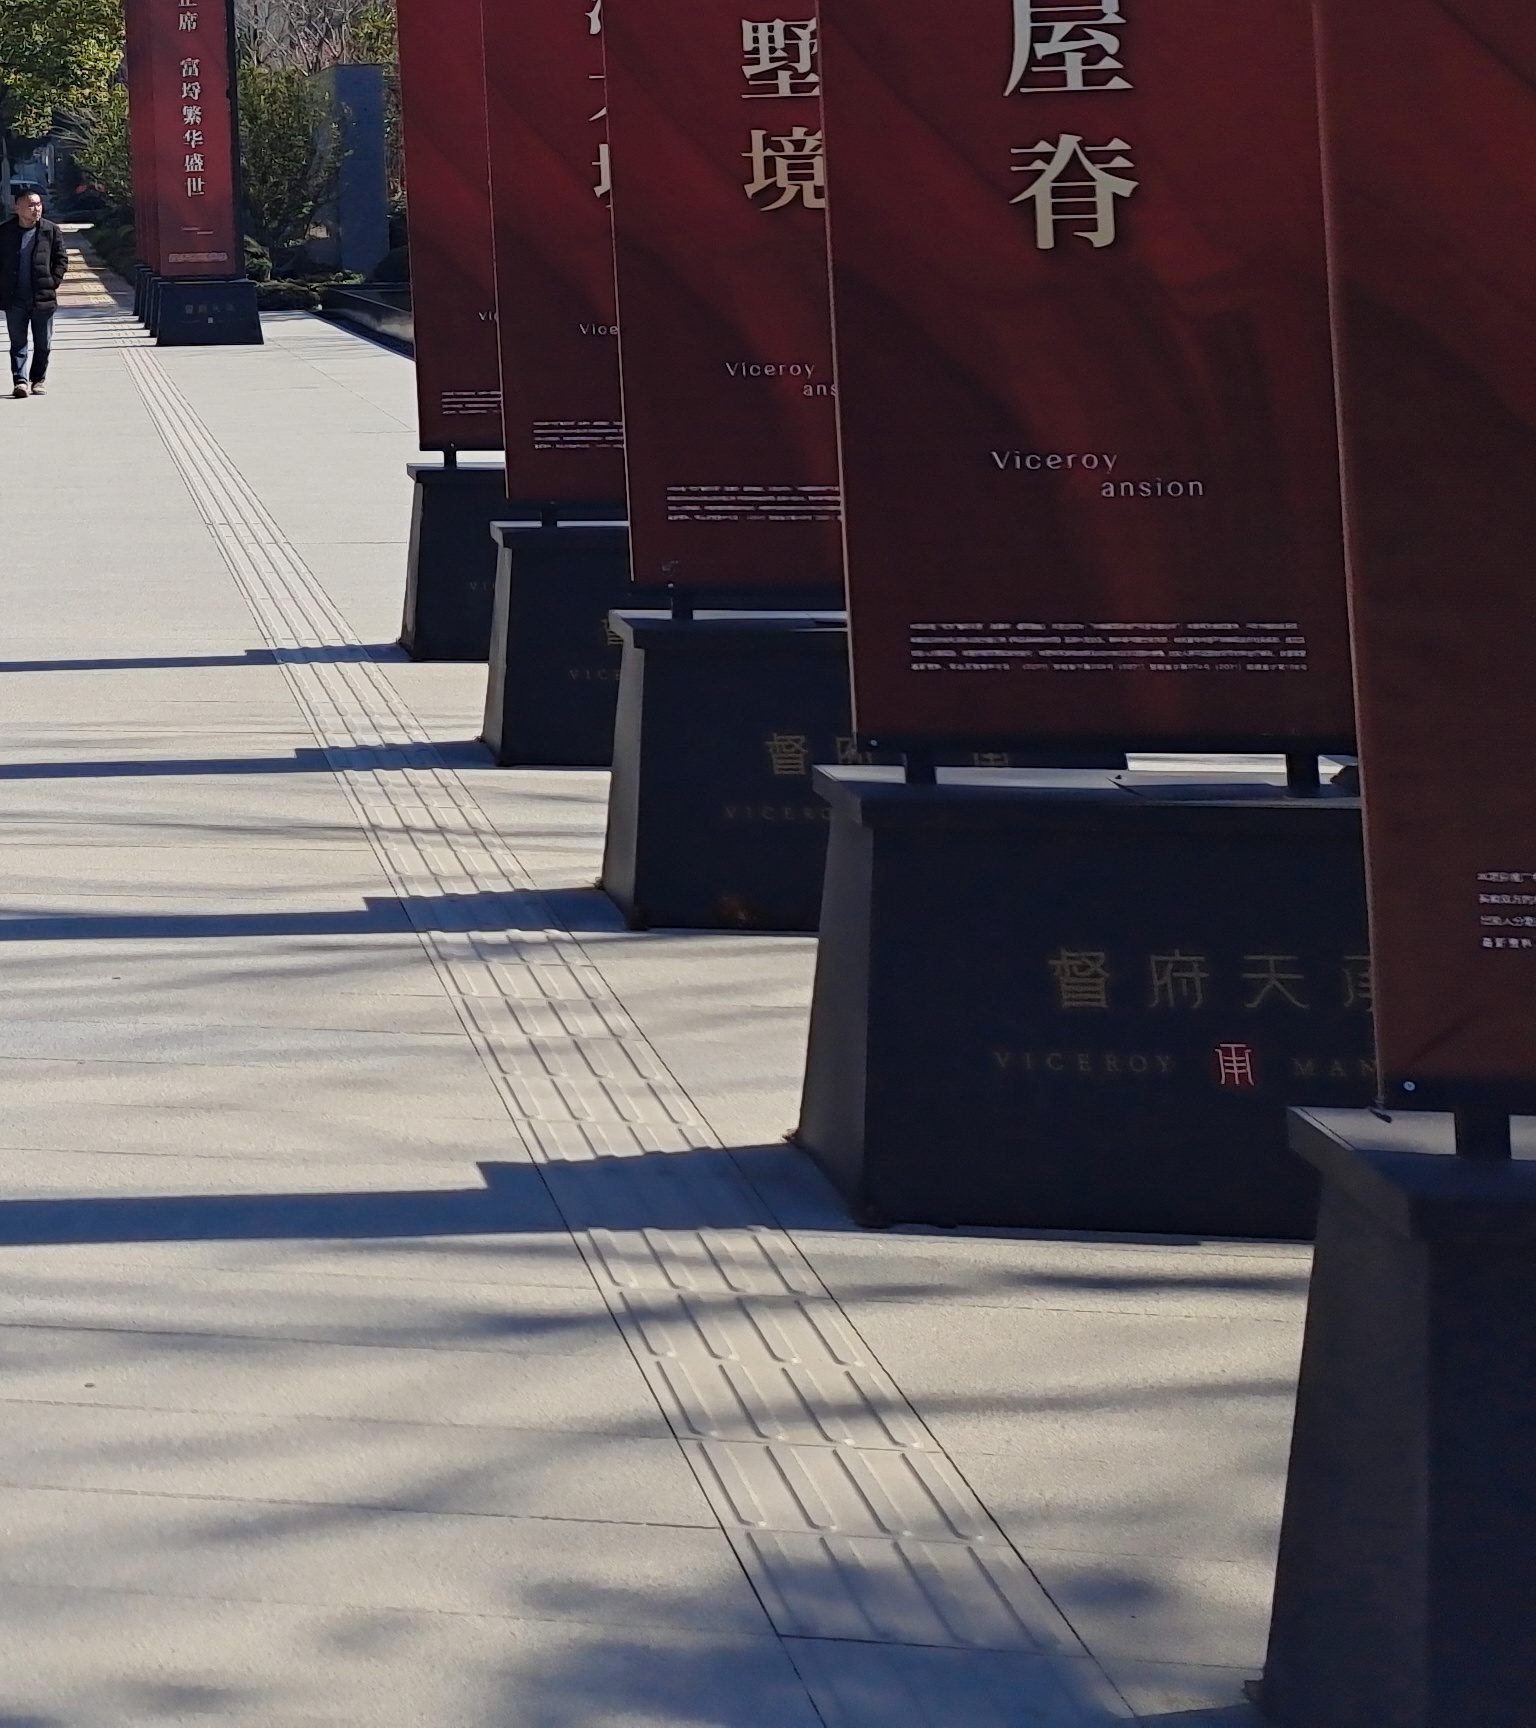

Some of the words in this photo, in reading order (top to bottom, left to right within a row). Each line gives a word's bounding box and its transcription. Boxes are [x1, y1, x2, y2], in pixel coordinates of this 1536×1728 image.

[725, 361, 815, 379] Viceroy
[991, 448, 1119, 474] Viceroy
[1100, 476, 1205, 499] ansion
